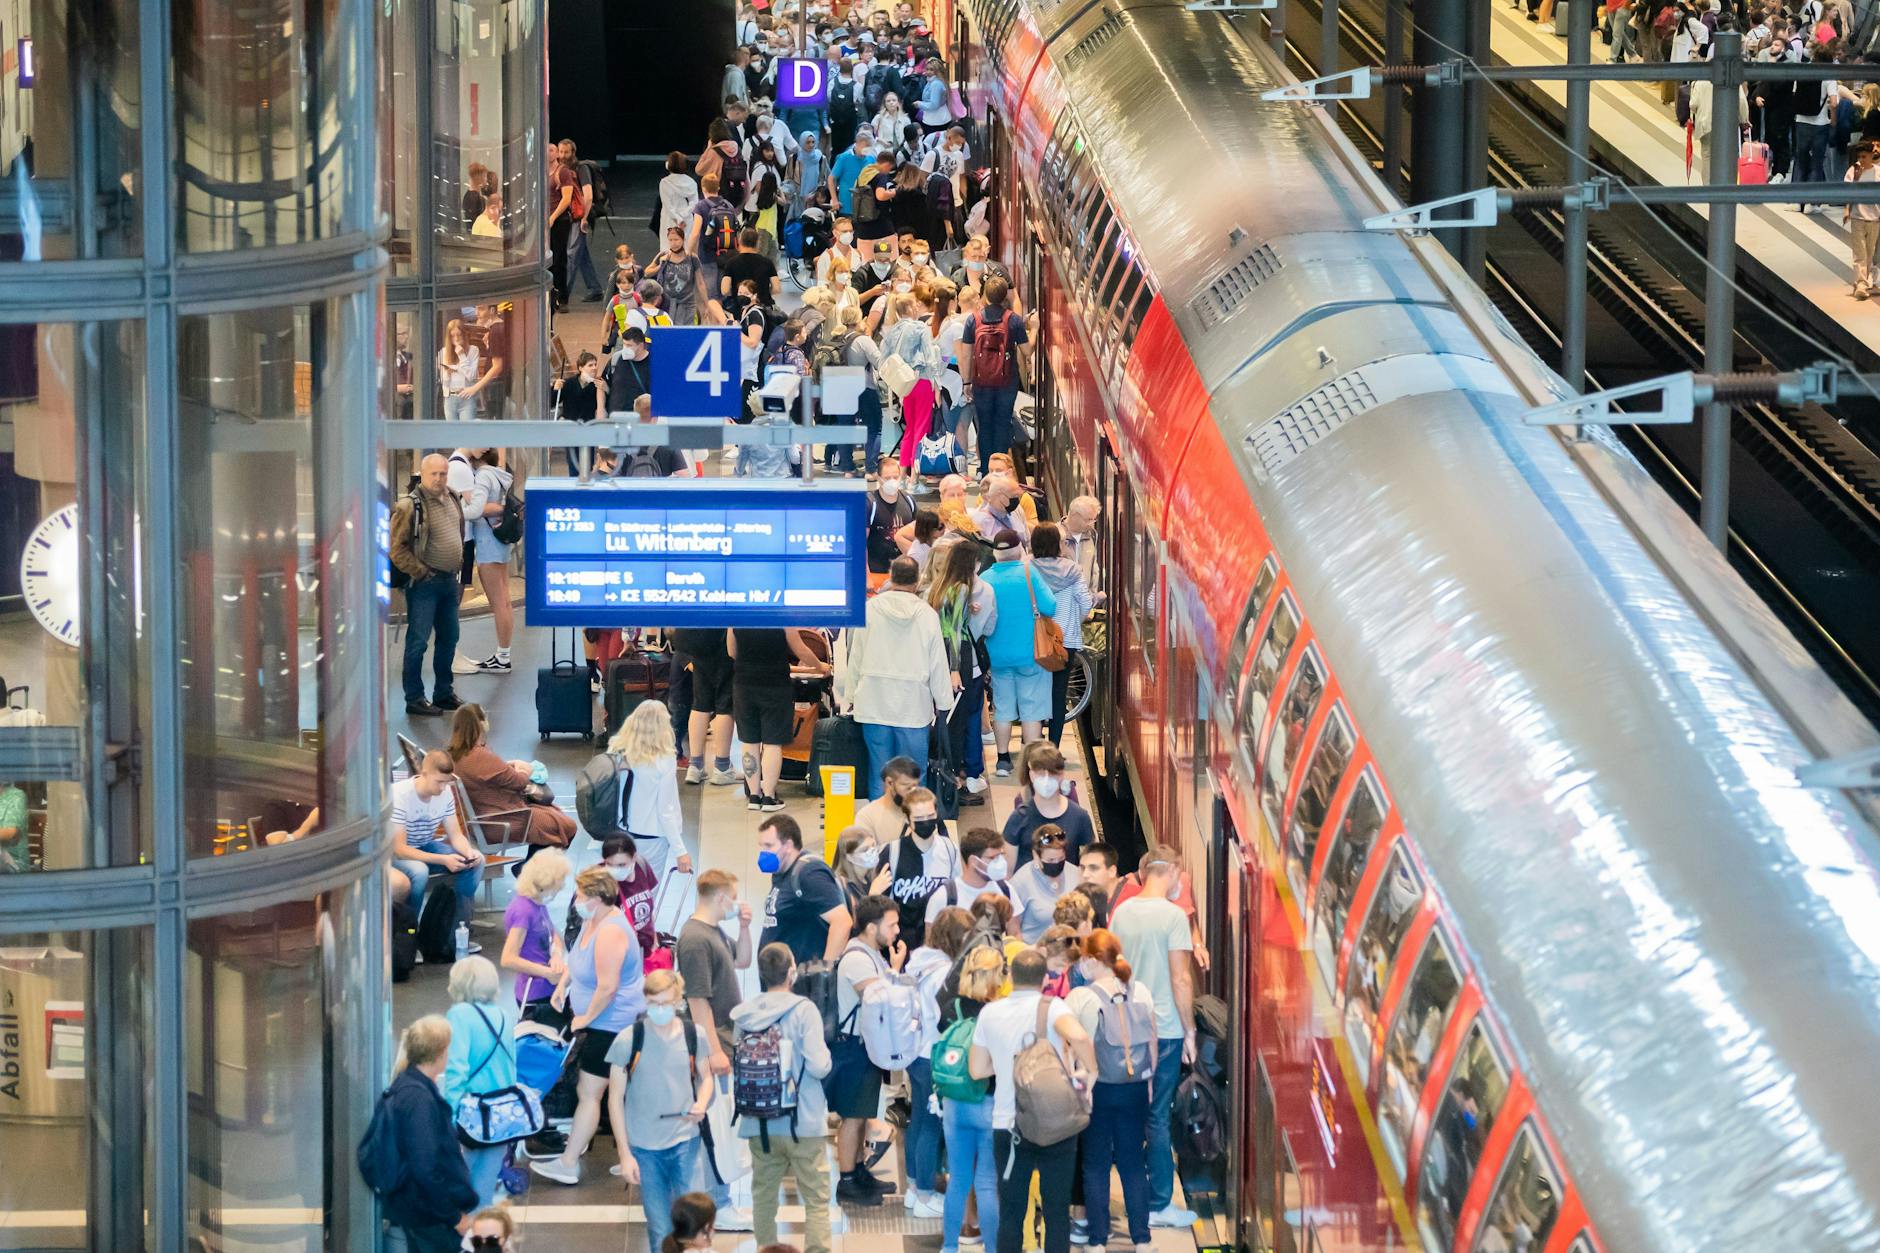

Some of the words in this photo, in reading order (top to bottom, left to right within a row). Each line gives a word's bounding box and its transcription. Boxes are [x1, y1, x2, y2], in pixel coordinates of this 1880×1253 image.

[794, 60, 822, 98] D
[685, 331, 730, 397] 4
[635, 534, 733, 555] Wittenberg
[621, 590, 641, 602] ICE
[700, 590, 746, 603] Koblenz
[0, 1014, 20, 1100] Abfall
